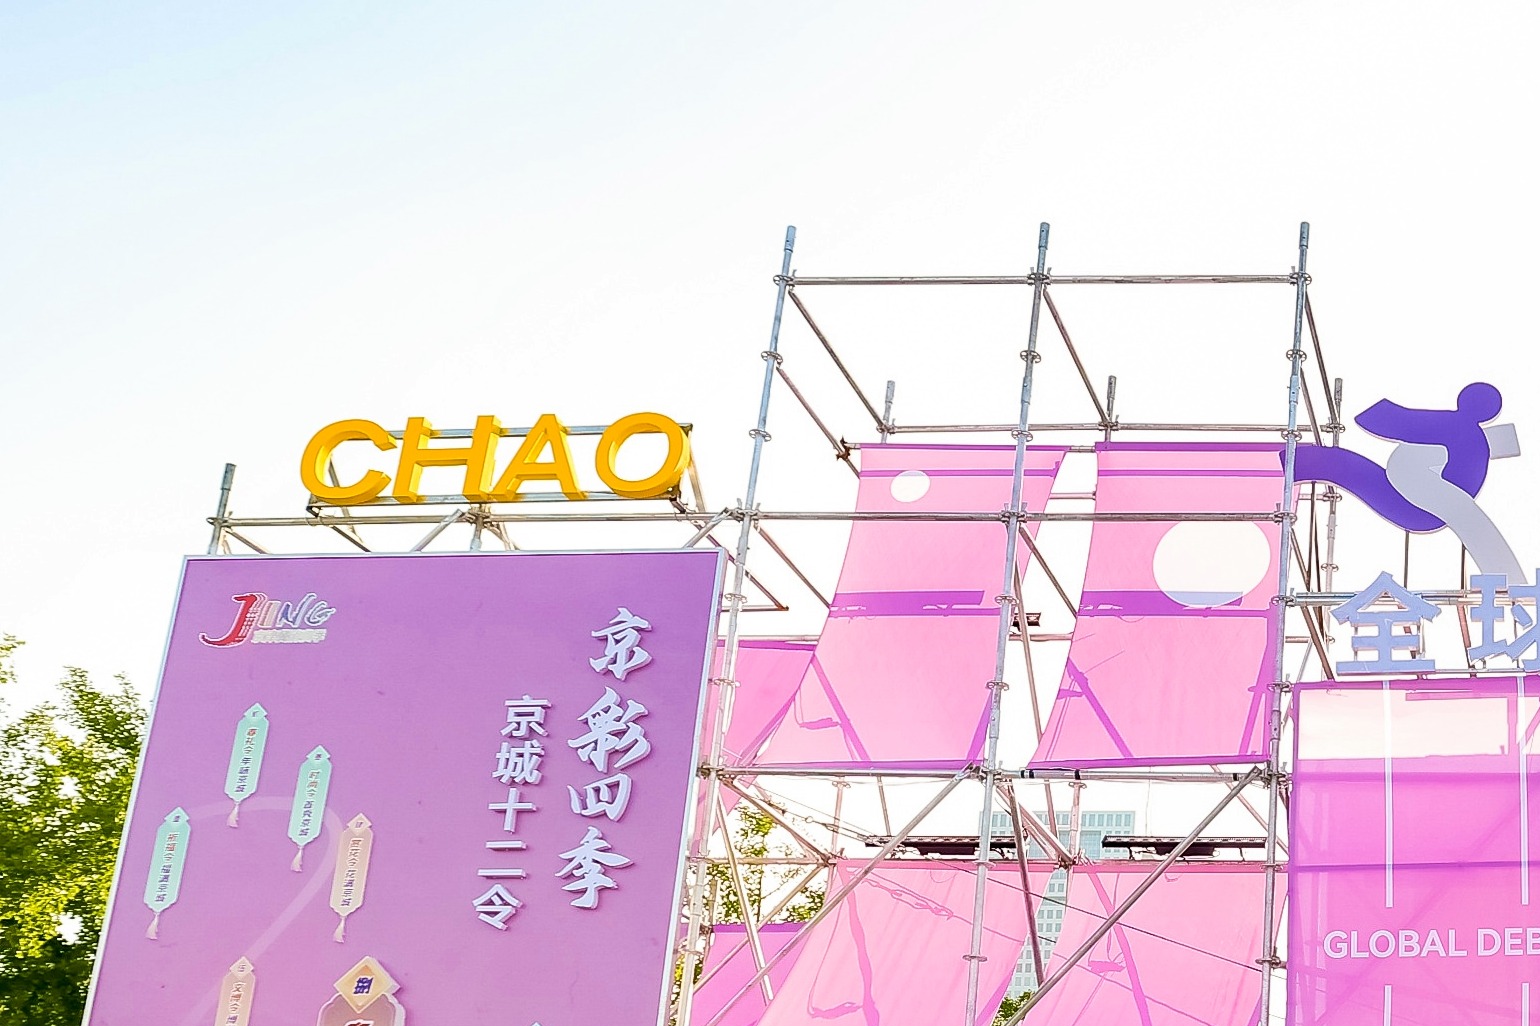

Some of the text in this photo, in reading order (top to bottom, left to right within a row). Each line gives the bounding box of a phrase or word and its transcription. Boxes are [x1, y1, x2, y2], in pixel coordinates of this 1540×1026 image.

[301, 411, 690, 504] CHAO
[472, 694, 553, 932] 京城十二令
[554, 606, 653, 911] 京彩四季
[1323, 927, 1469, 961] GLOBAL
